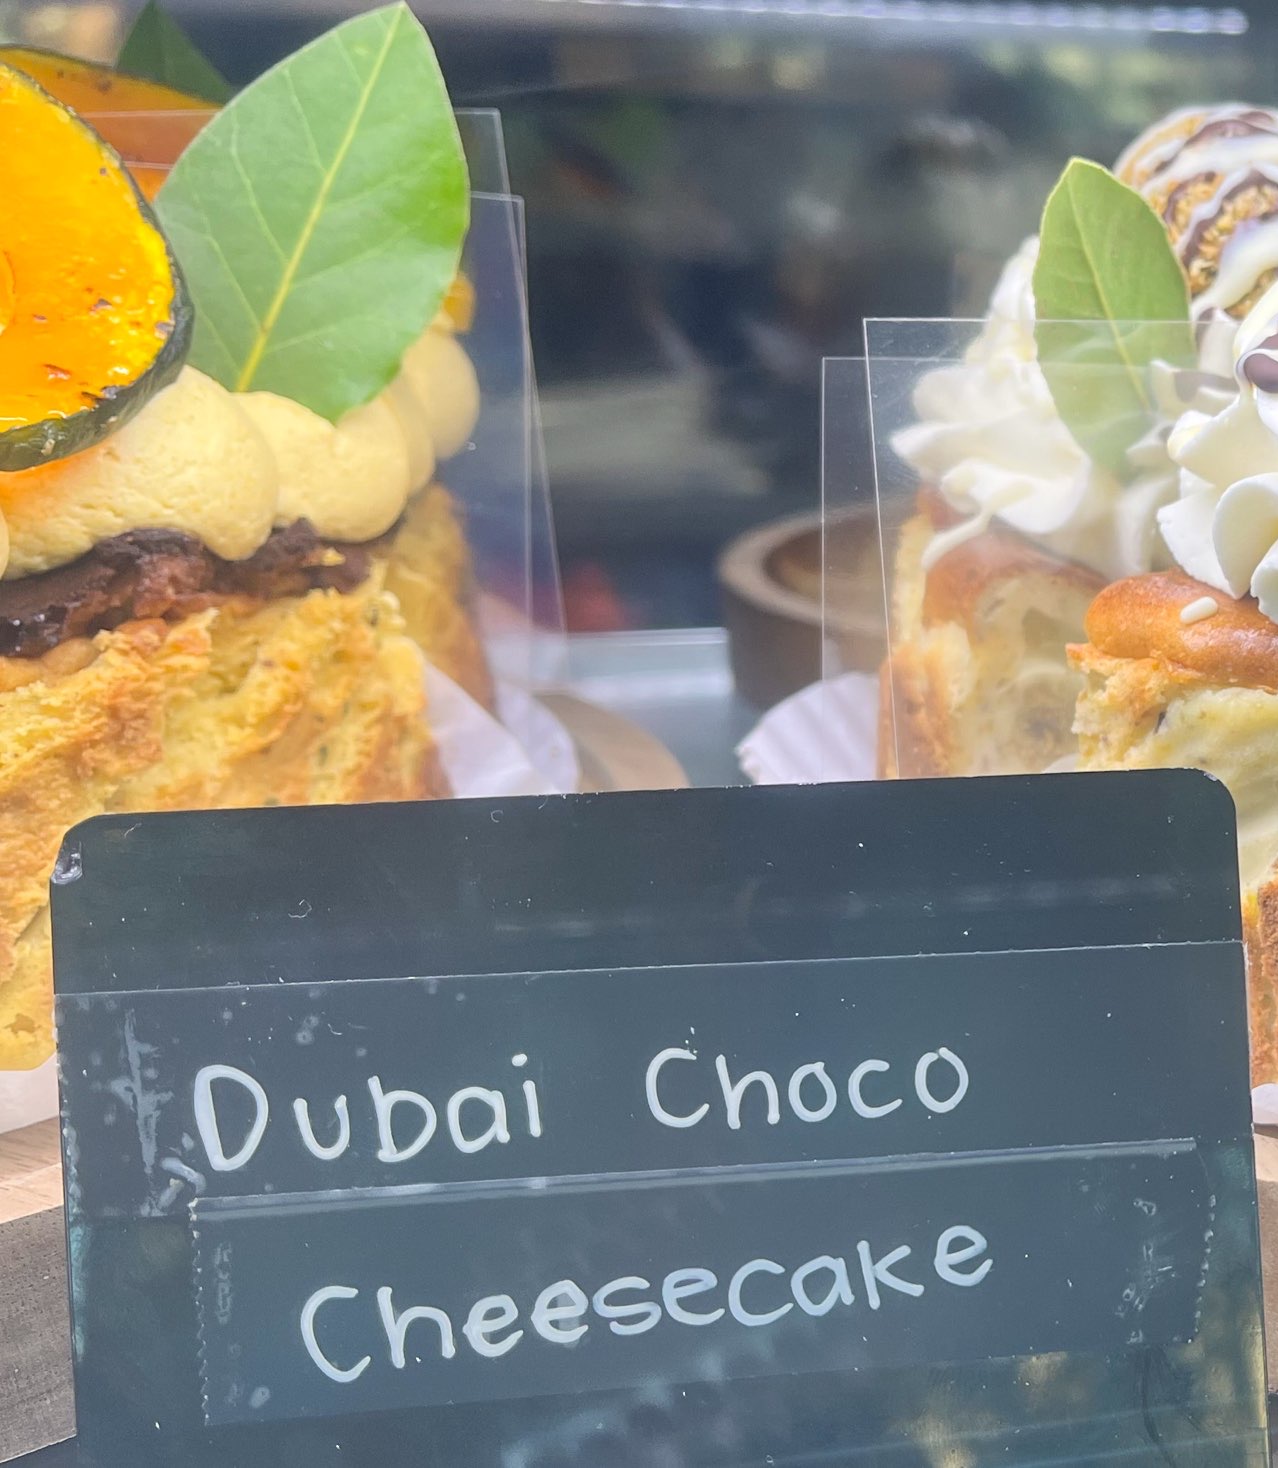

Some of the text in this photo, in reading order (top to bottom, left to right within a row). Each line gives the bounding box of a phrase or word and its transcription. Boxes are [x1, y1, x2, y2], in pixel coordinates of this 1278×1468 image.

[193, 1046, 970, 1172] Dubai Choco
[300, 1225, 993, 1384] Cheesecake
